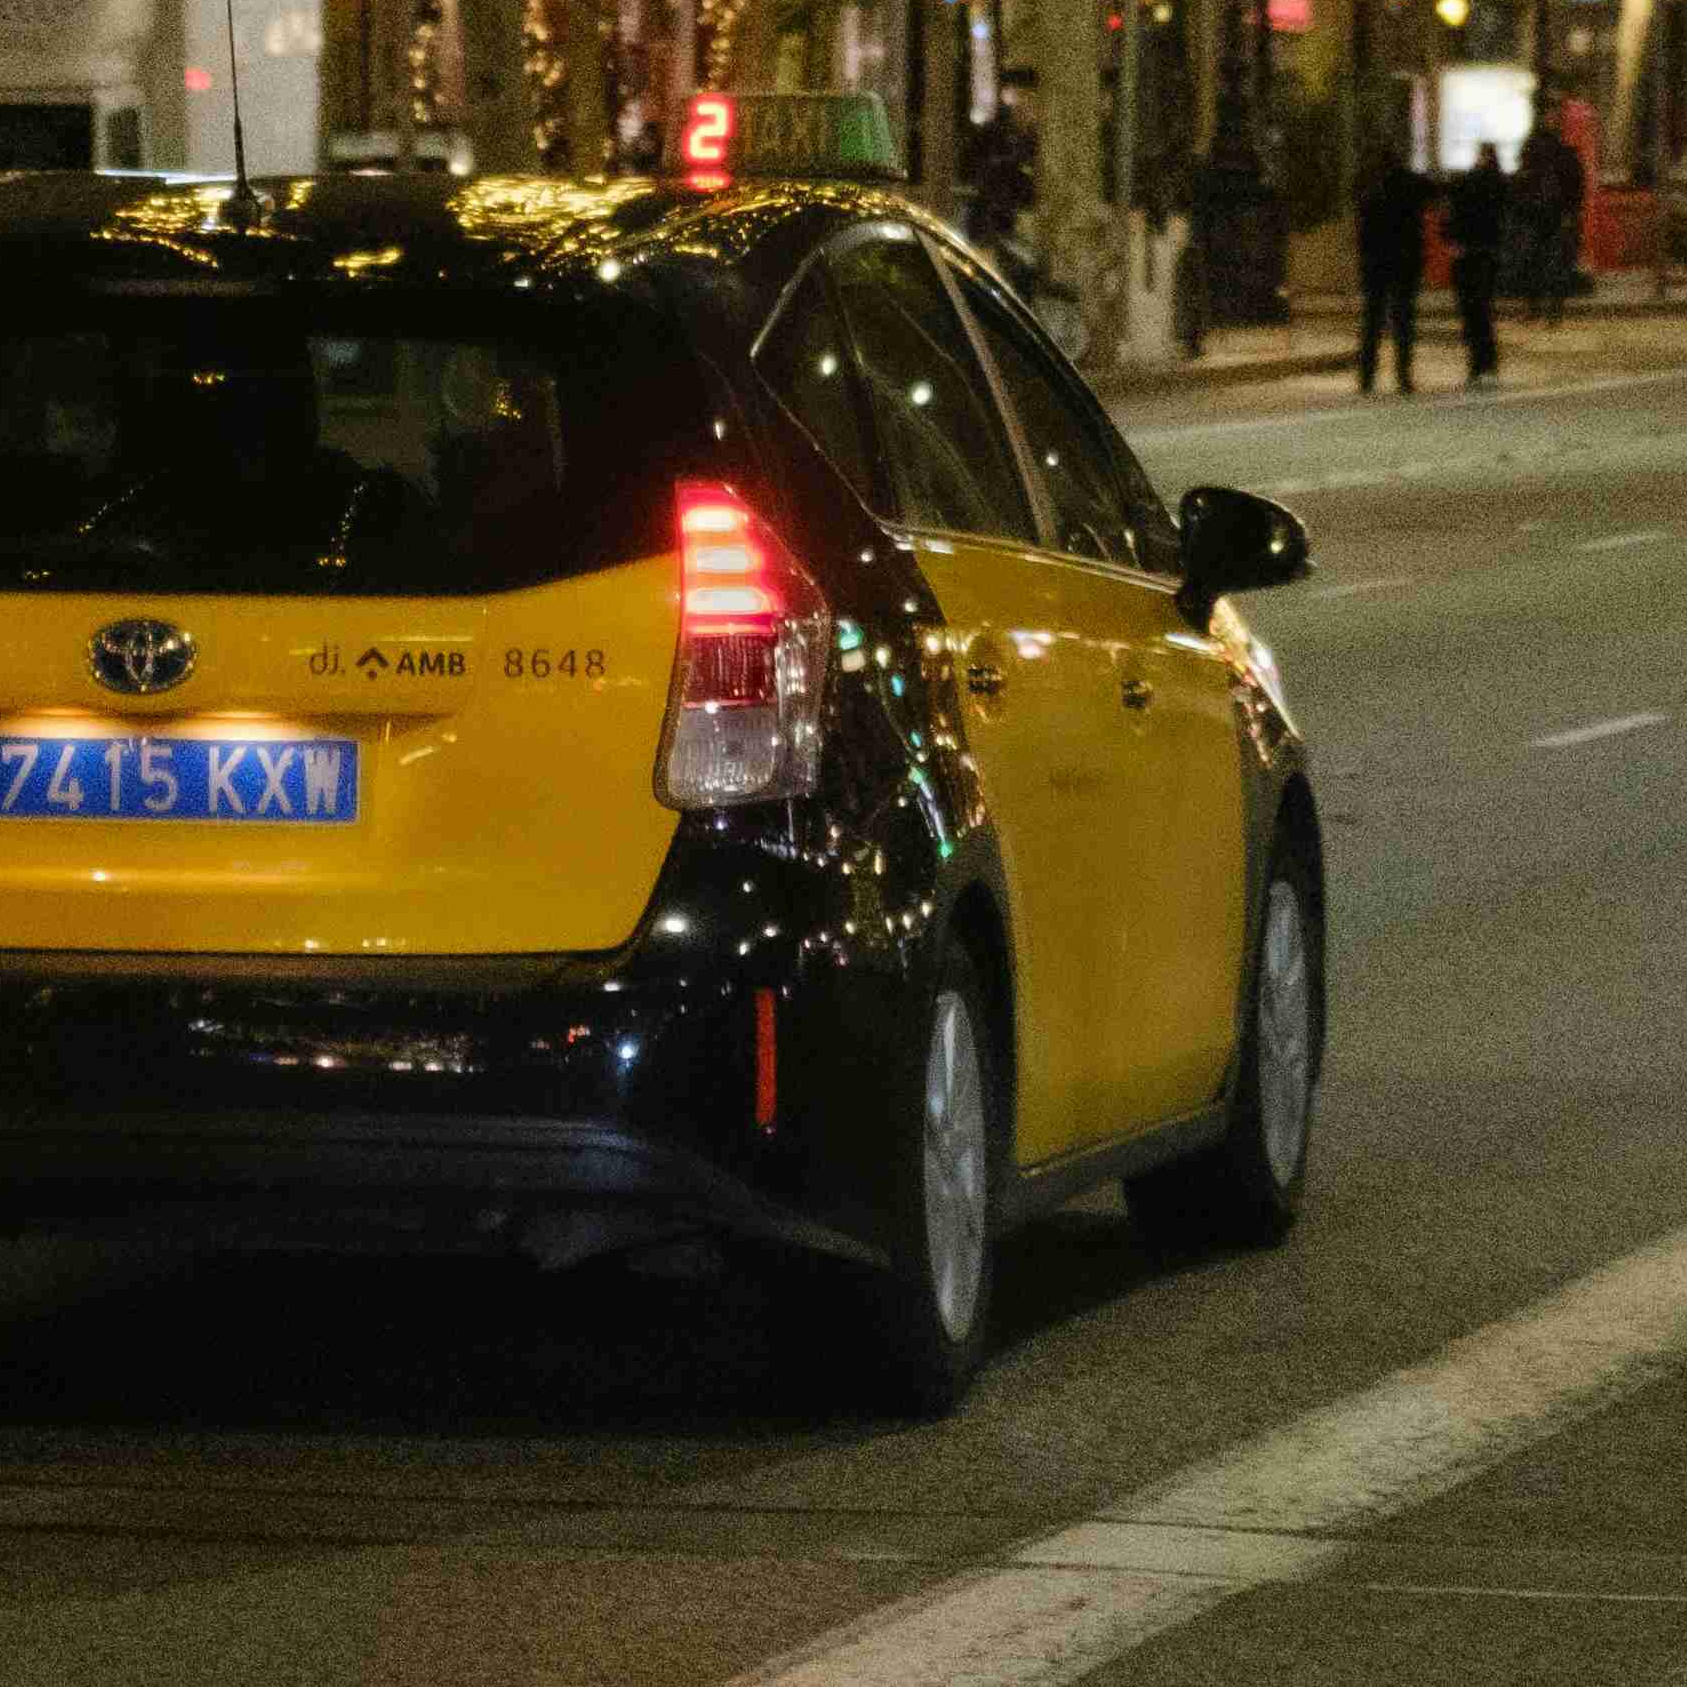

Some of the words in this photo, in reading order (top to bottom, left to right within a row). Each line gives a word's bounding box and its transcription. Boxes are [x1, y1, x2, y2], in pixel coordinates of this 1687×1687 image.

[686, 98, 731, 162] 2
[396, 649, 466, 676] AMB
[504, 647, 605, 679] 8648
[0, 743, 179, 812] 7415
[208, 743, 342, 814] KXW
